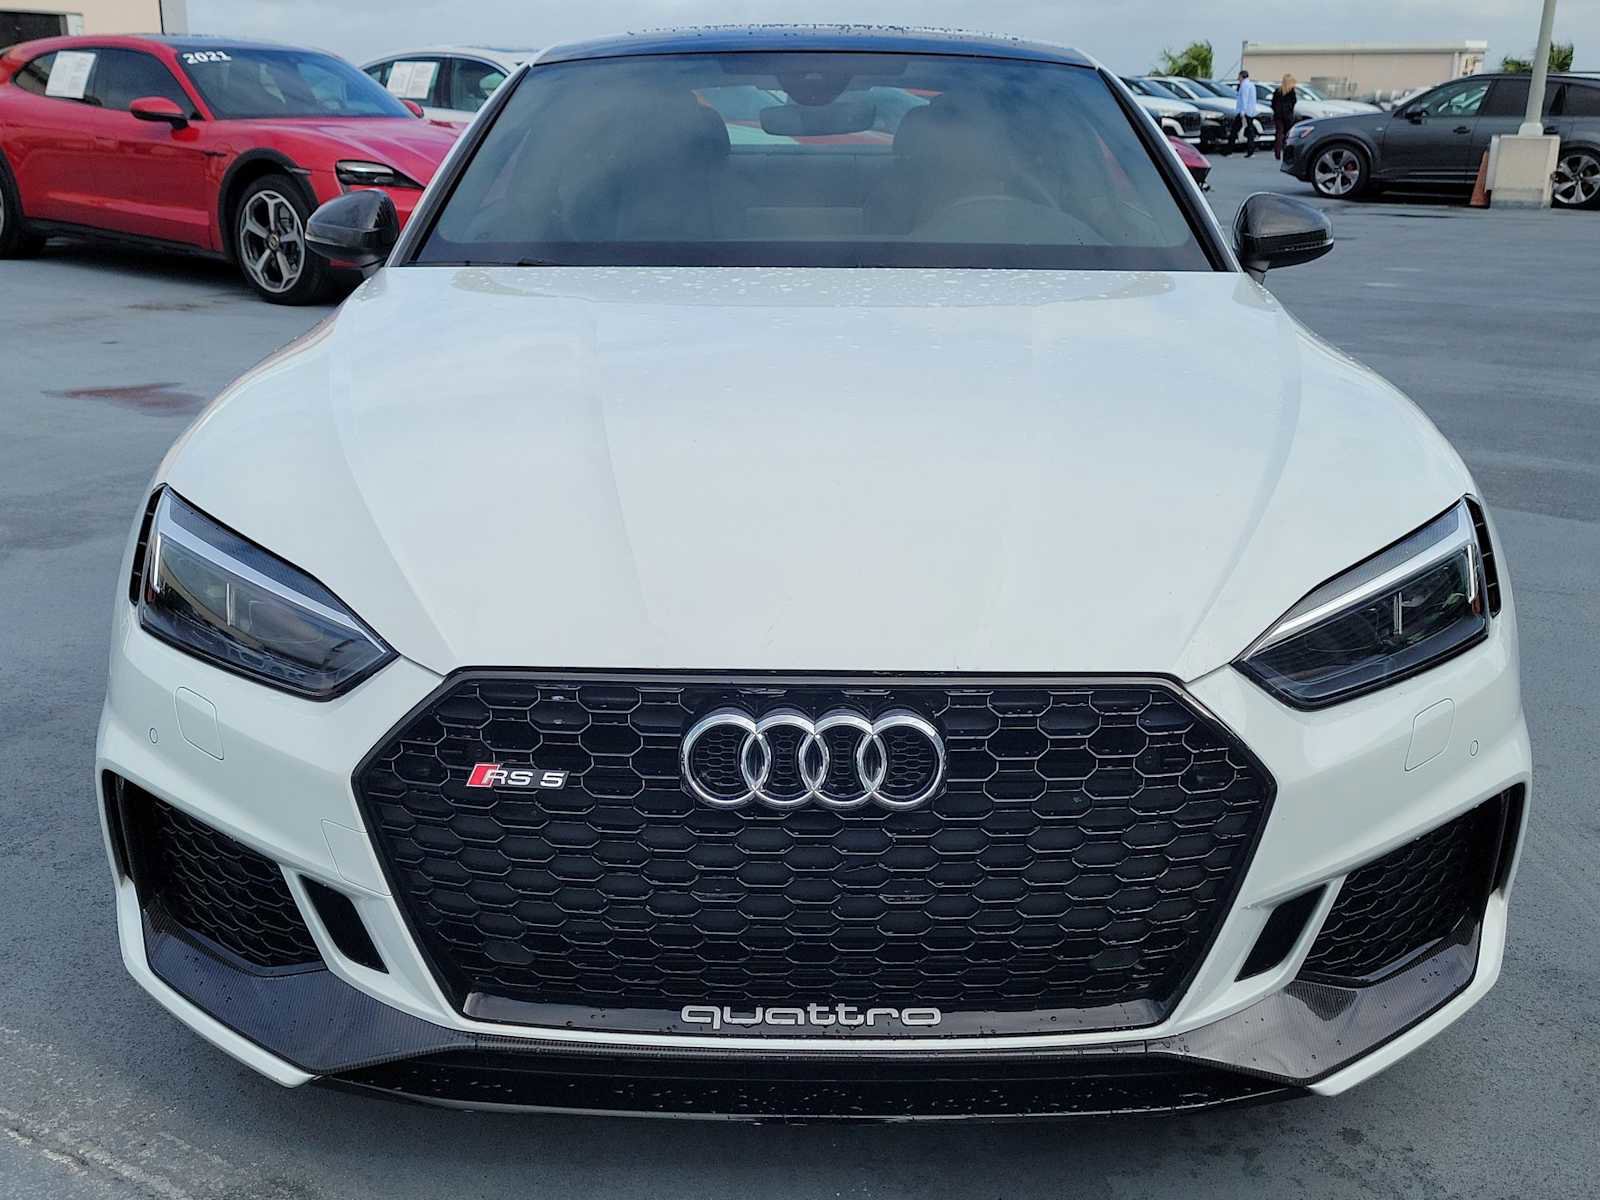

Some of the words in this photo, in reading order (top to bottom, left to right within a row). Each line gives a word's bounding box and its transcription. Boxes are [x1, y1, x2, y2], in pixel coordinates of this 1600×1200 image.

[182, 50, 232, 65] 2021
[479, 768, 534, 786] RS
[540, 772, 566, 788] 5
[680, 1002, 942, 1030] quattro
